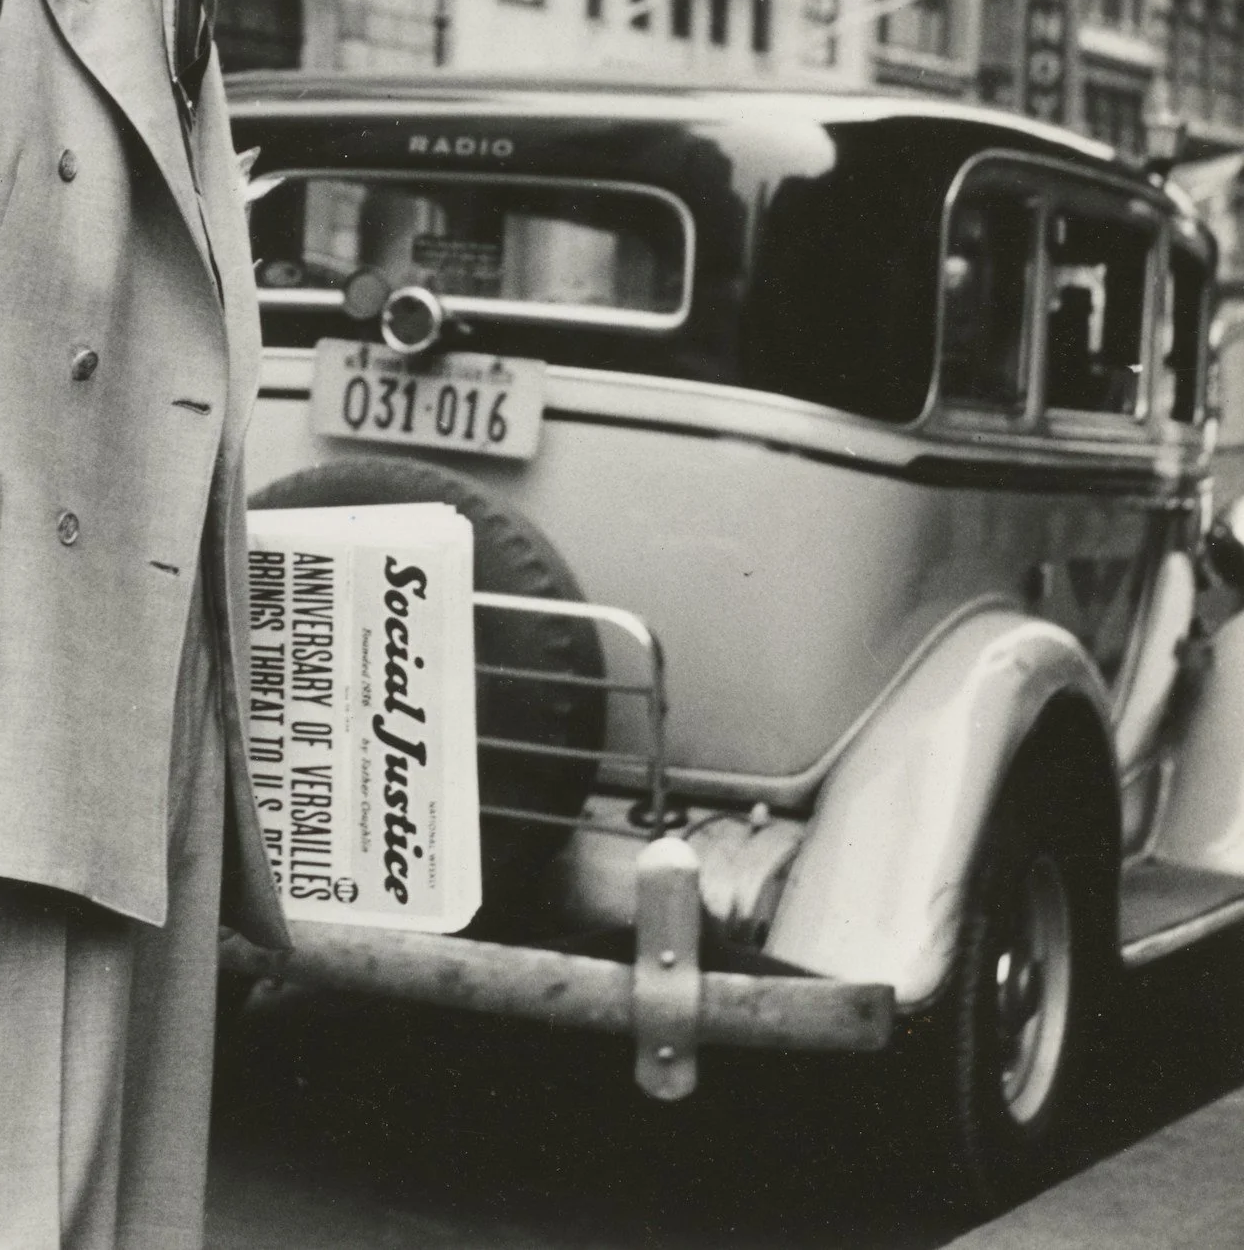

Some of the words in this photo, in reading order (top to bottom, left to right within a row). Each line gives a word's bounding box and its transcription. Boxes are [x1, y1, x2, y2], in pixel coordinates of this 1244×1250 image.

[408, 134, 514, 158] RADIO
[248, 550, 285, 631] BRINGS
[291, 551, 334, 708] ANNIVERSARY
[360, 627, 372, 678] Founded
[383, 554, 428, 724] Social
[249, 642, 285, 726] THREAT
[249, 736, 284, 763] TO
[291, 721, 333, 750] OF
[290, 765, 333, 901] VERSAILLES
[371, 713, 428, 906] Justice
